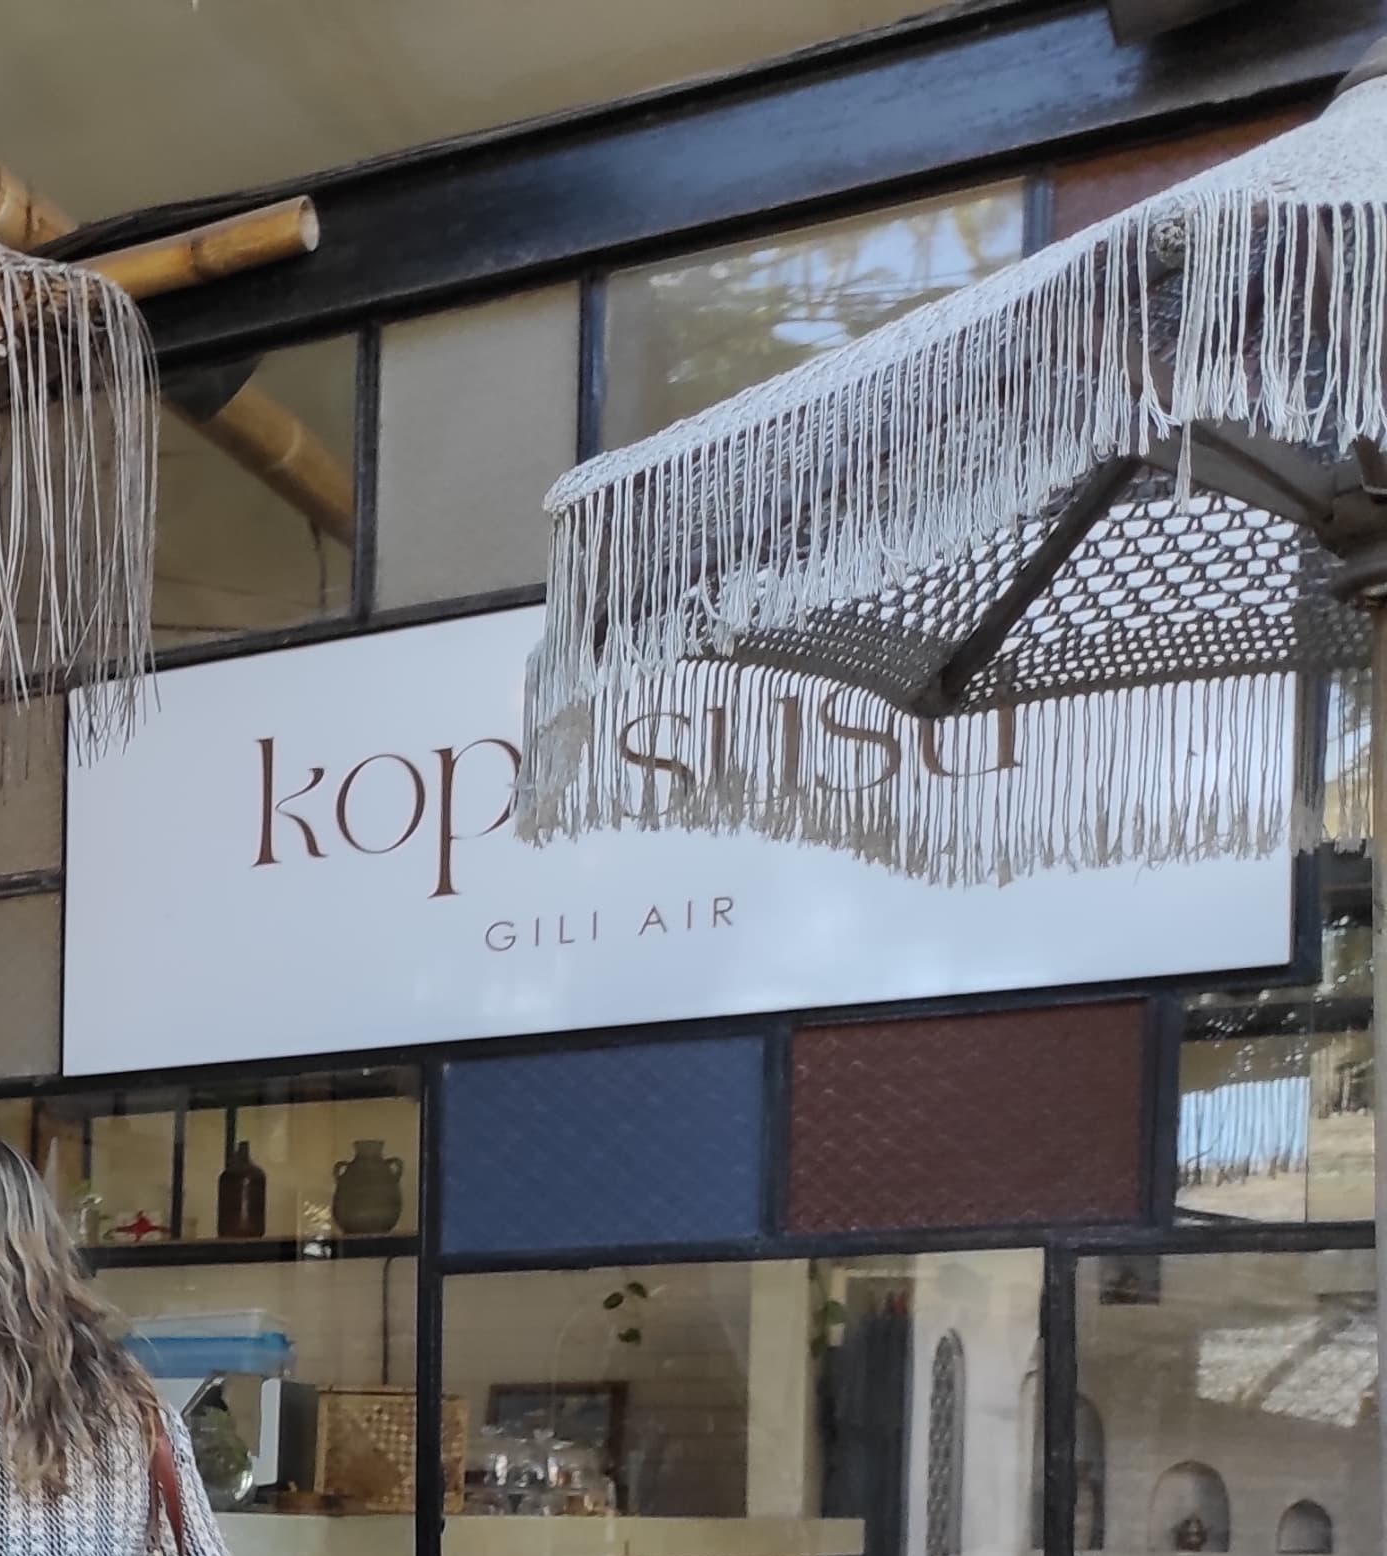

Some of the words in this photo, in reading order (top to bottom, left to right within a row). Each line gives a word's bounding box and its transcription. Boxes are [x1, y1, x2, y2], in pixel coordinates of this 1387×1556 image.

[252, 736, 527, 899] kop
[485, 910, 599, 951] GILI
[638, 896, 734, 936] AIR
